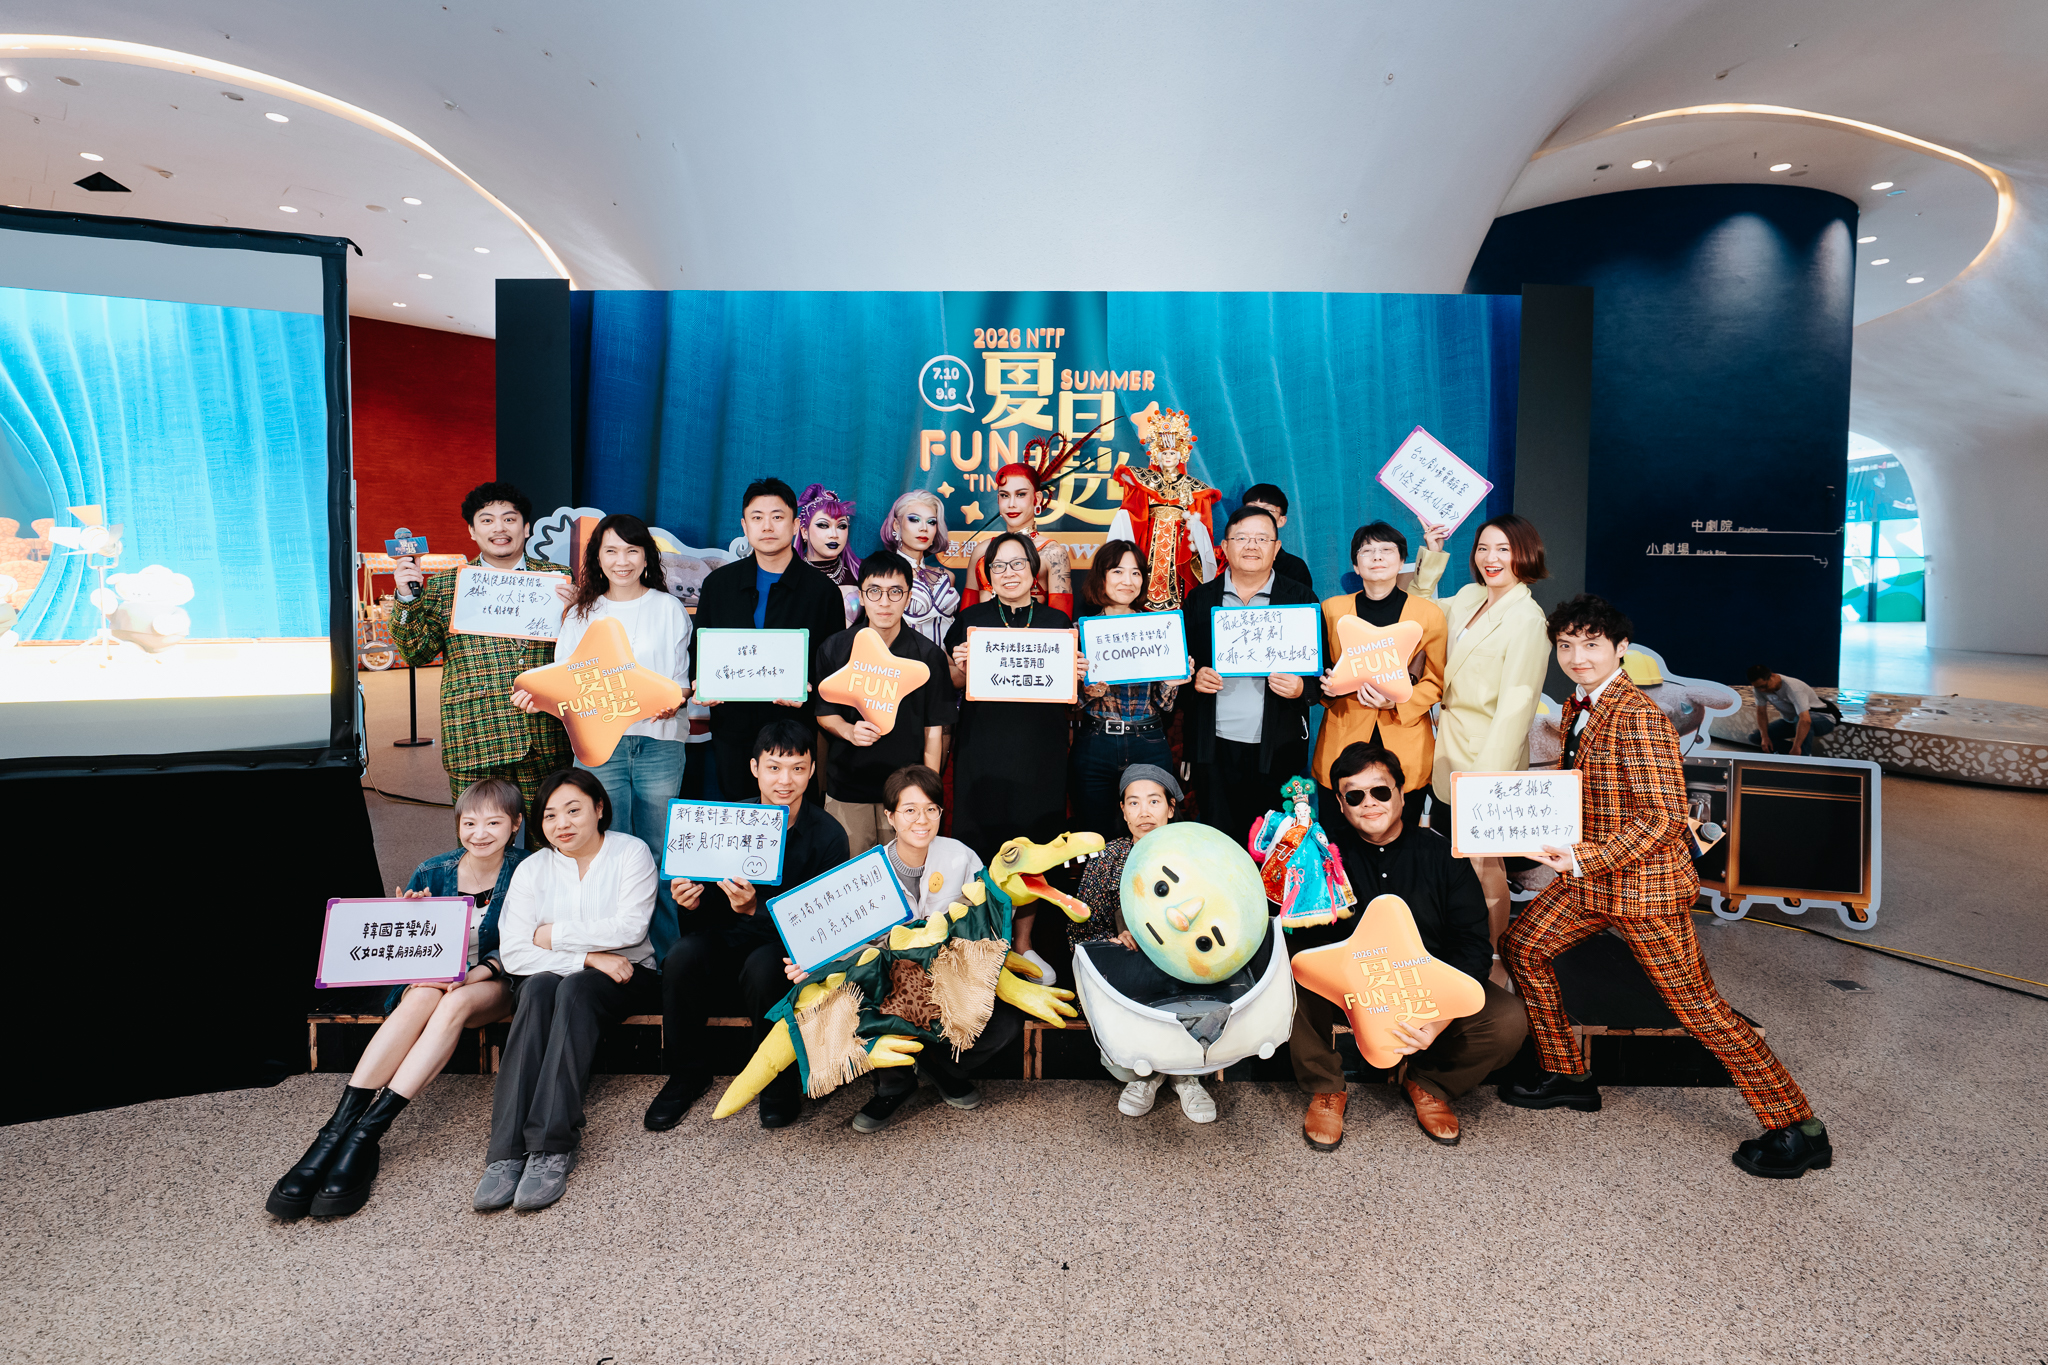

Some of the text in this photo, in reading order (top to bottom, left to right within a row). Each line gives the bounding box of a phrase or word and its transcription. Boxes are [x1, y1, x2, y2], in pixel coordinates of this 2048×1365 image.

[973, 328, 1065, 349] 2026 NTT
[932, 367, 960, 380] 7.10
[1060, 368, 1155, 391] SUMMER
[935, 387, 957, 400] 9.6
[920, 430, 1018, 472] FUN
[963, 474, 998, 492] TIM
[1691, 519, 1733, 532] 中劇院
[1646, 542, 1690, 555] 小劇場
[1346, 637, 1395, 657] SUMMER
[567, 661, 585, 672] 2026
[602, 662, 636, 677] SUMMER
[853, 660, 902, 679] SUMMER
[1350, 648, 1401, 677] FUN
[1372, 669, 1405, 685] TIME
[848, 673, 899, 701] FUN
[557, 694, 597, 717] FUN
[577, 708, 598, 719] TIME
[864, 698, 895, 713] TIME
[362, 919, 437, 939] 韓國音樂劇
[1352, 950, 1371, 960] 2026
[1392, 956, 1432, 969] SUMMER
[1344, 988, 1387, 1010] FUN
[1366, 1005, 1390, 1014] TIME
